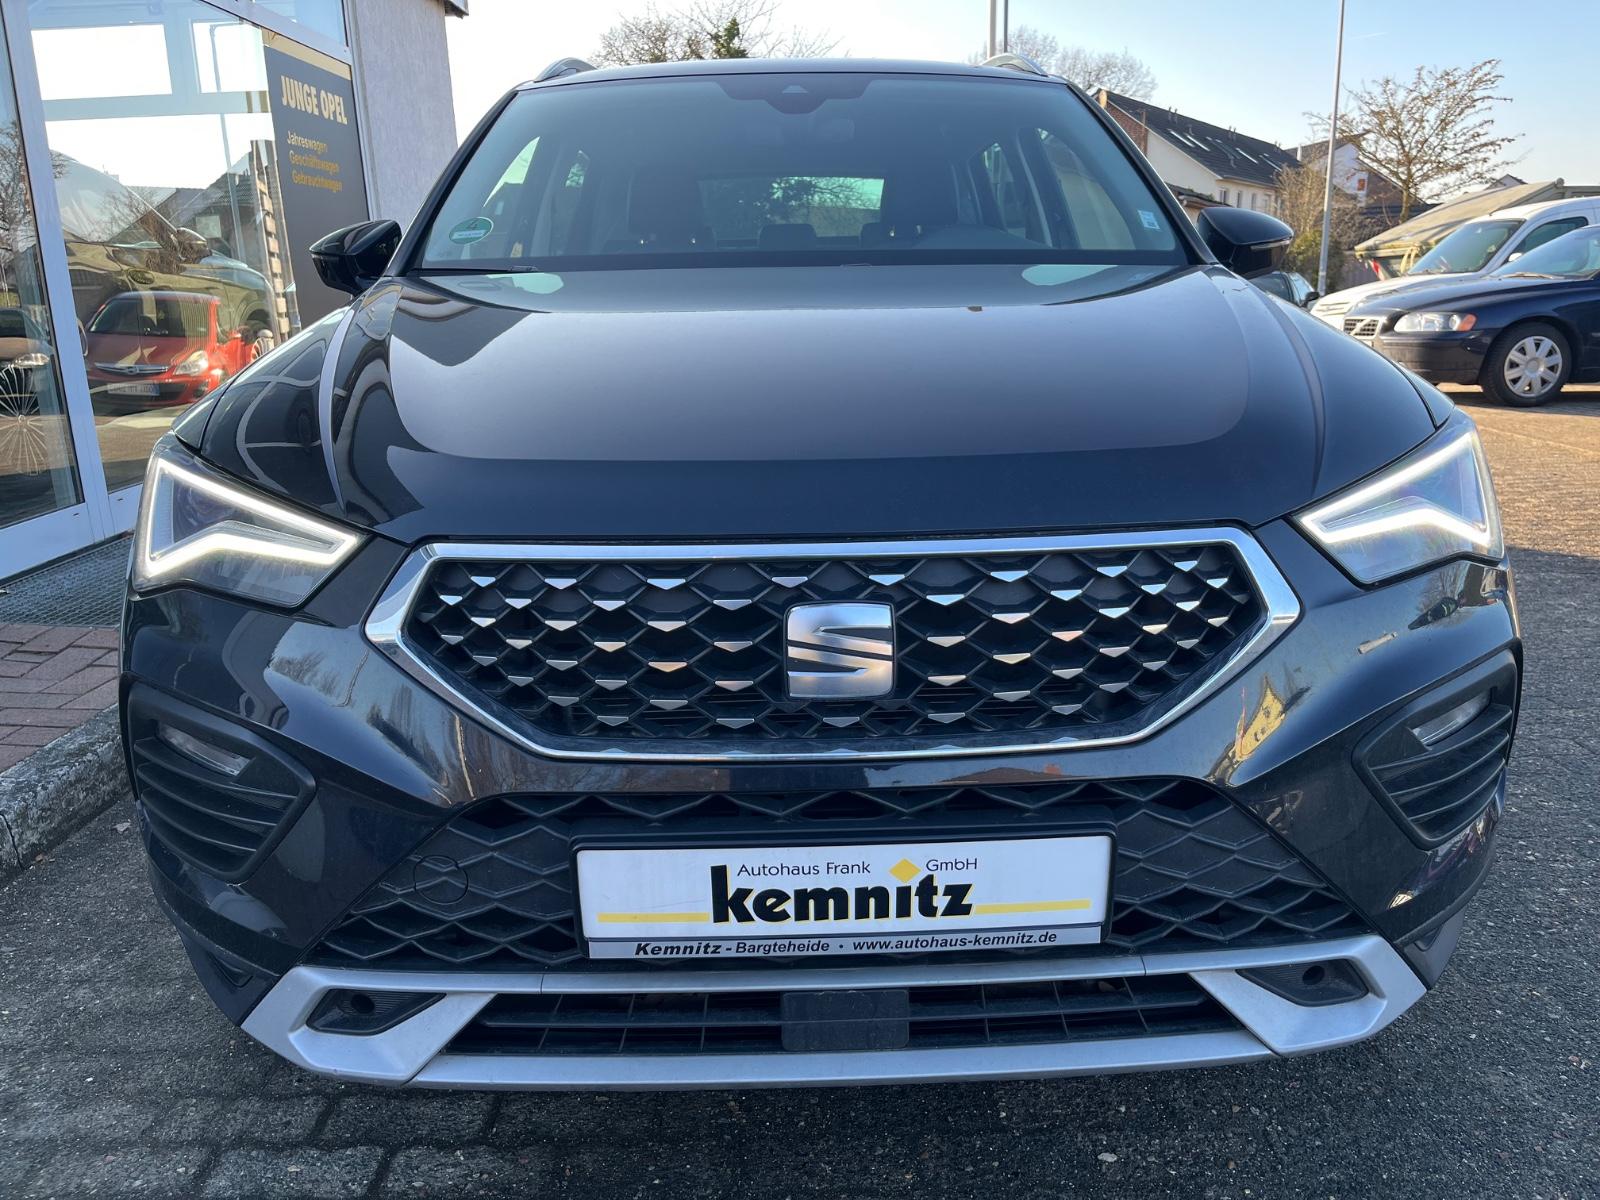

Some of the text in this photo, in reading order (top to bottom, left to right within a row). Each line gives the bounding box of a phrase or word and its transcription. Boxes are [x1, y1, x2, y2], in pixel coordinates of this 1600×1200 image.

[281, 75, 348, 125] JUNGE OPEL
[287, 130, 328, 154] Jahreswagen
[737, 858, 978, 877] Autohaus Frank GmbH
[711, 860, 973, 924] kemnitz
[635, 942, 721, 956] Kemnitz
[735, 940, 830, 955] Bargteheide
[852, 931, 1057, 951] www.autohaus-kemnitz.de
